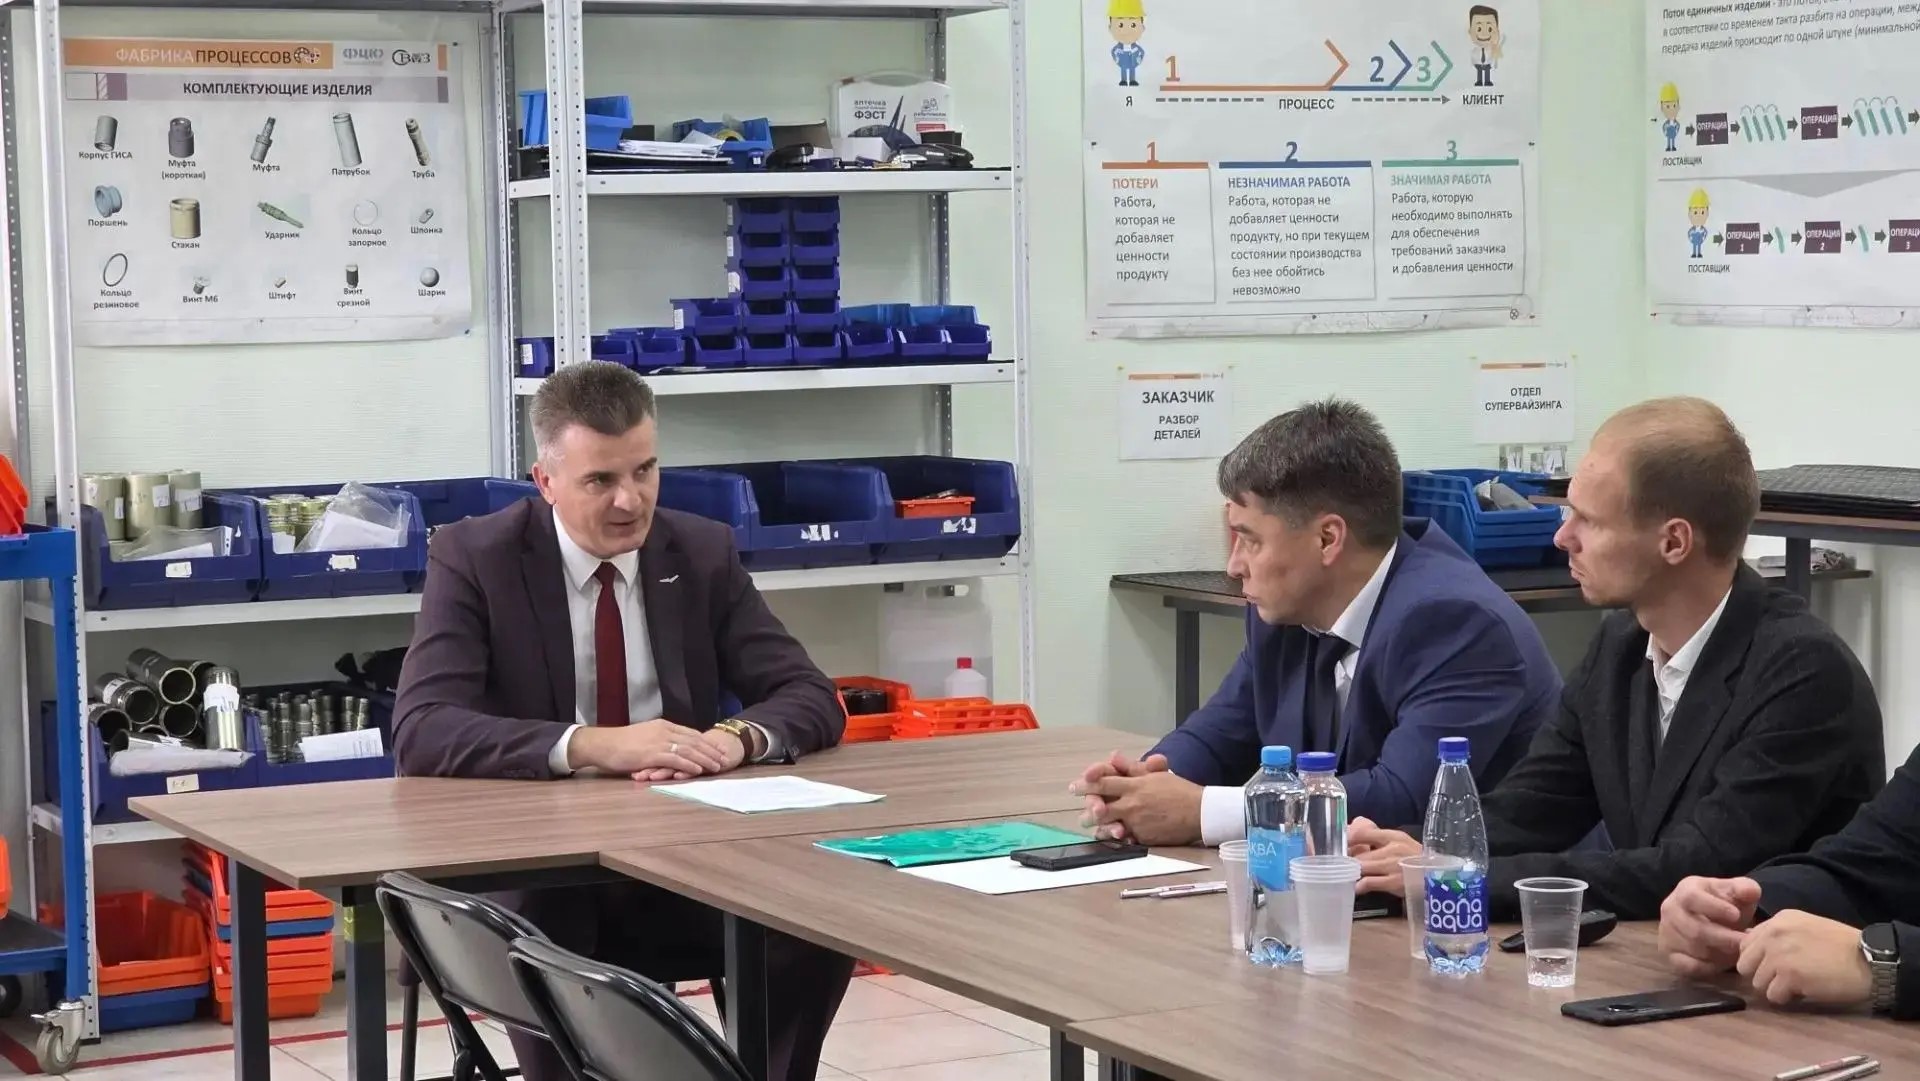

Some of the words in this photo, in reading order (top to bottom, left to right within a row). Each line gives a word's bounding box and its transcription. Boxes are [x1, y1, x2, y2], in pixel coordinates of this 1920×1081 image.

[1662, 9, 1685, 19] Поток
[1686, 4, 1733, 18] единичных
[1669, 22, 1719, 36] соответствии
[1720, 23, 1729, 31] со
[1730, 18, 1774, 32] временем
[1776, 16, 1798, 26] такта
[1800, 11, 1834, 27] разбита
[1836, 11, 1847, 20] на
[1849, 6, 1895, 22] операции,
[1661, 41, 1699, 55] передача
[1700, 38, 1733, 50] изделий
[1734, 33, 1782, 49] происходит
[1784, 34, 1795, 43] по
[1797, 28, 1824, 44] одной
[1825, 29, 1852, 41] штуке
[115, 46, 194, 64] ФАБРИКА
[195, 49, 292, 67] ПРОЦЕССОВ
[1165, 56, 1181, 82] 1
[1370, 56, 1385, 82] 2
[1416, 56, 1431, 82] 3
[183, 82, 309, 98] КОМПЛЕКТУЮЩИЕ
[312, 83, 373, 97] ИЗДЕЛИЯ
[1125, 96, 1133, 107] Я
[1278, 98, 1335, 111] ПРОЦЕСС
[1462, 94, 1505, 106] КЛИЕНТ
[854, 110, 887, 120] ФЭСТ
[1801, 113, 1839, 125] ОПЕРАЦИЯ
[1696, 120, 1728, 131] ОПЕРАЦИЯ
[78, 151, 109, 162] Корпус
[110, 151, 133, 160] ГИСА
[1146, 142, 1157, 161] 1
[1285, 142, 1298, 162] 2
[1446, 140, 1458, 161] 3
[168, 159, 197, 169] Муфта
[1662, 156, 1703, 167] ПОСТАВЩИК
[252, 163, 280, 173] Муфта
[331, 167, 371, 178] Патрубок
[161, 171, 206, 181] (короткая)
[411, 170, 436, 180] Труба
[1390, 174, 1450, 186] ЗНАЧИМАЯ
[1452, 173, 1492, 186] РАБОТА
[1112, 178, 1159, 190] ПОТЕРИ
[1228, 177, 1306, 189] НЕЗНАЧИМАЯ
[1308, 176, 1351, 188] РАБОТА
[1114, 196, 1156, 209] Работа,
[1228, 195, 1270, 208] Работа,
[1272, 197, 1315, 208] которая
[1317, 196, 1331, 206] не
[1391, 191, 1429, 205] Работа,
[1432, 193, 1474, 205] которую
[1115, 216, 1160, 227] которая
[1162, 216, 1176, 226] не
[1229, 213, 1287, 226] добавляет
[1289, 213, 1340, 226] ценности
[1391, 209, 1454, 222] необходимо
[1457, 209, 1513, 221] выполнять
[88, 218, 128, 228] Поршень
[264, 231, 300, 241] Ударник
[352, 227, 383, 237] Кольцо
[410, 226, 443, 236] Шпонка
[1230, 231, 1283, 245] продукту,
[1285, 232, 1298, 242] но
[1301, 232, 1322, 245] при
[1324, 229, 1370, 243] текущем
[1391, 228, 1410, 240] для
[1413, 227, 1480, 240] обеспечения
[1726, 230, 1760, 240] ОПЕРАЦИЯ
[1806, 229, 1841, 239] ОПЕРАЦИЯ
[348, 239, 387, 249] запорное
[1115, 232, 1175, 245] добавляет
[171, 241, 200, 250] Стакан
[1391, 244, 1453, 258] требований
[1455, 244, 1506, 256] заказчика
[1739, 244, 1745, 252] 1
[1819, 243, 1825, 251] 2
[1905, 241, 1911, 250] 3
[1116, 251, 1170, 263] ценности
[1231, 249, 1287, 261] состоянии
[1289, 247, 1362, 262] производства
[1232, 265, 1250, 278] без
[1252, 267, 1273, 278] нее
[1275, 263, 1326, 279] обойтись
[1392, 265, 1399, 274] и
[1401, 262, 1464, 275] добавления
[1466, 260, 1514, 273] ценности
[1687, 264, 1730, 274] ПОСТАВЩИК
[1116, 269, 1169, 283] продукту
[100, 289, 132, 299] Кольцо
[269, 291, 297, 301] Штифт
[343, 287, 363, 296] Винт
[418, 289, 446, 298] Шарик
[1232, 284, 1301, 296] невозможно
[182, 296, 203, 304] Винт
[204, 295, 219, 304] М6
[337, 297, 371, 309] срезной
[93, 301, 140, 311] резиновое
[1142, 390, 1215, 404] ЗАКАЗЧИК
[1510, 387, 1541, 397] ОТДЕЛ
[1485, 399, 1562, 411] СУПЕРВАЙЗИНГА
[1158, 415, 1200, 425] РАЗБОР
[1153, 427, 1201, 440] ДЕТАЛЕЙ
[1248, 841, 1277, 857] КВА
[1430, 914, 1482, 933] aqua
